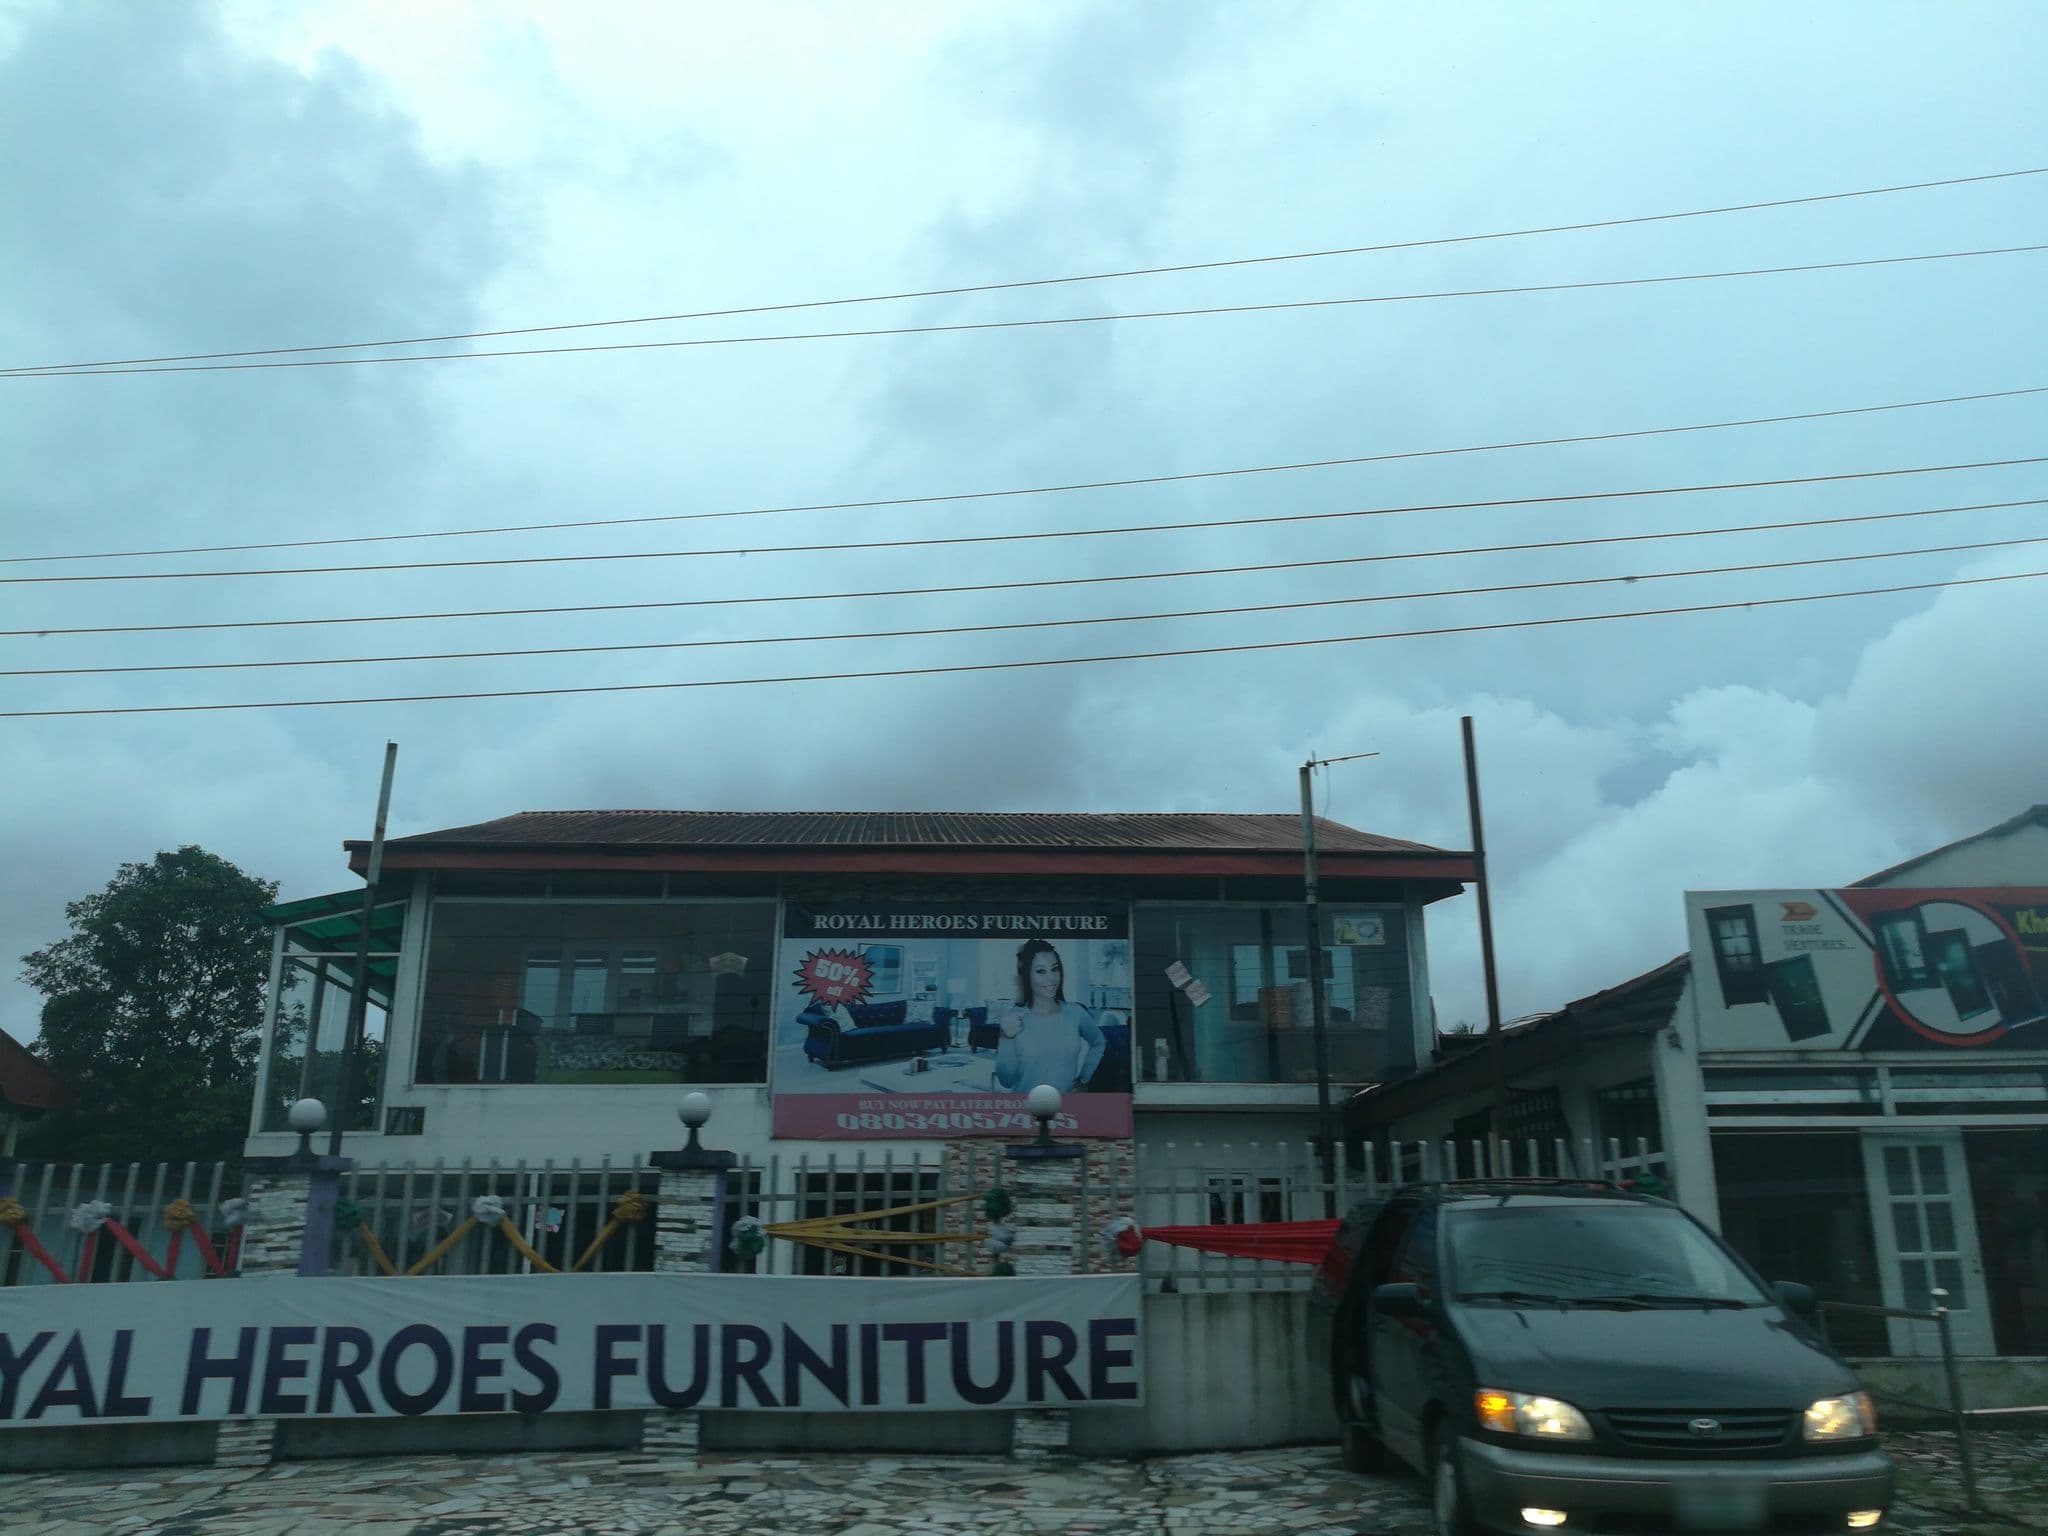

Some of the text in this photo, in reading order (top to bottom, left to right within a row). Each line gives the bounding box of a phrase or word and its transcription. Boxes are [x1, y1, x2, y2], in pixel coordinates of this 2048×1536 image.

[813, 914, 1108, 930] ROYAL HEROES FURNITURE
[815, 958, 860, 987] 50%
[858, 1099, 1029, 1110] BUY NOW PAY LATER PRO
[836, 1112, 1079, 1130] 0803405745
[180, 1322, 561, 1416] HEROES
[593, 1318, 1137, 1410] FURNITURE
